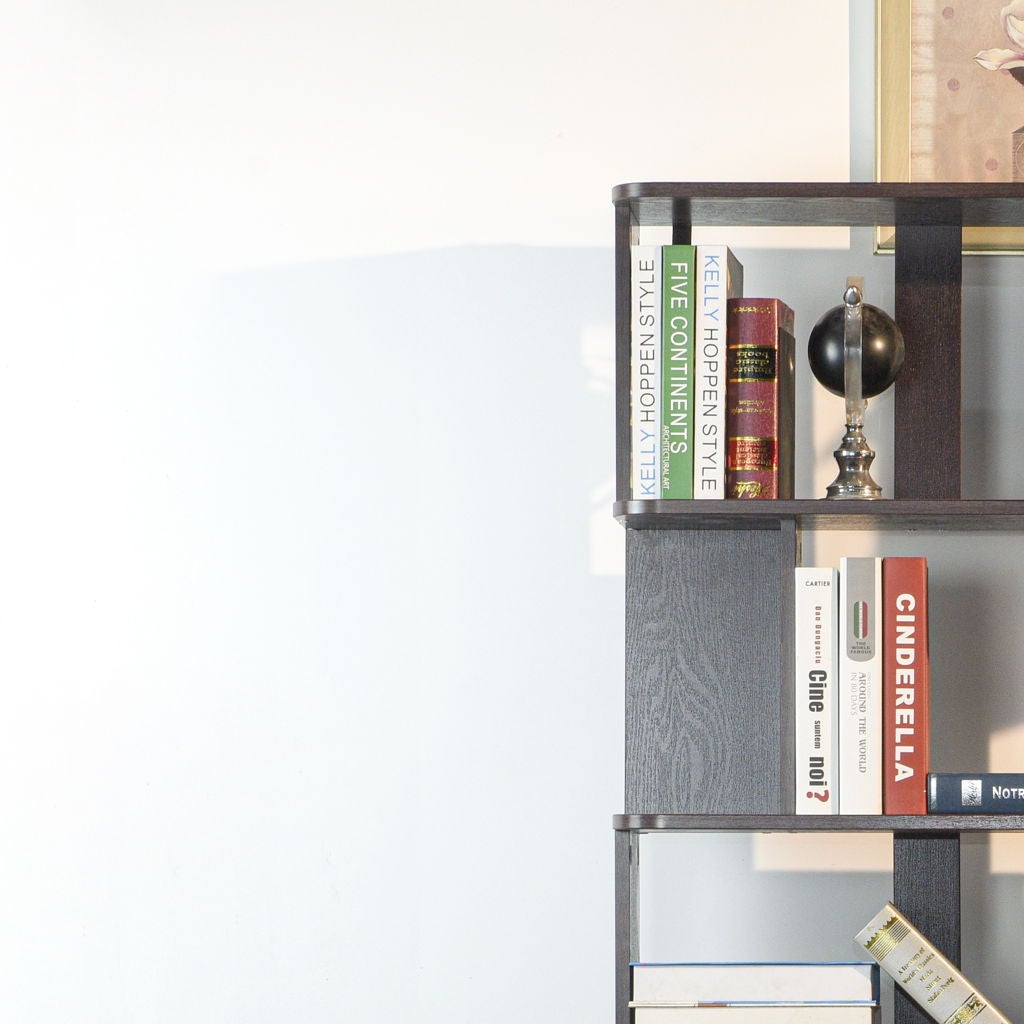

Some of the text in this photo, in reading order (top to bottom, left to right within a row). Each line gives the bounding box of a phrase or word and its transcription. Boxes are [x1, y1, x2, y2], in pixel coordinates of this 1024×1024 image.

[640, 260, 656, 495] KELLY HOPPEN STYLE
[670, 262, 688, 453] FIVE CONTINENTS
[702, 256, 719, 490] KELLY HOPPEN STYLE
[808, 670, 827, 712] Cine
[851, 673, 857, 681] IN
[851, 683, 857, 694] 80
[895, 593, 915, 782] CINDERELLA
